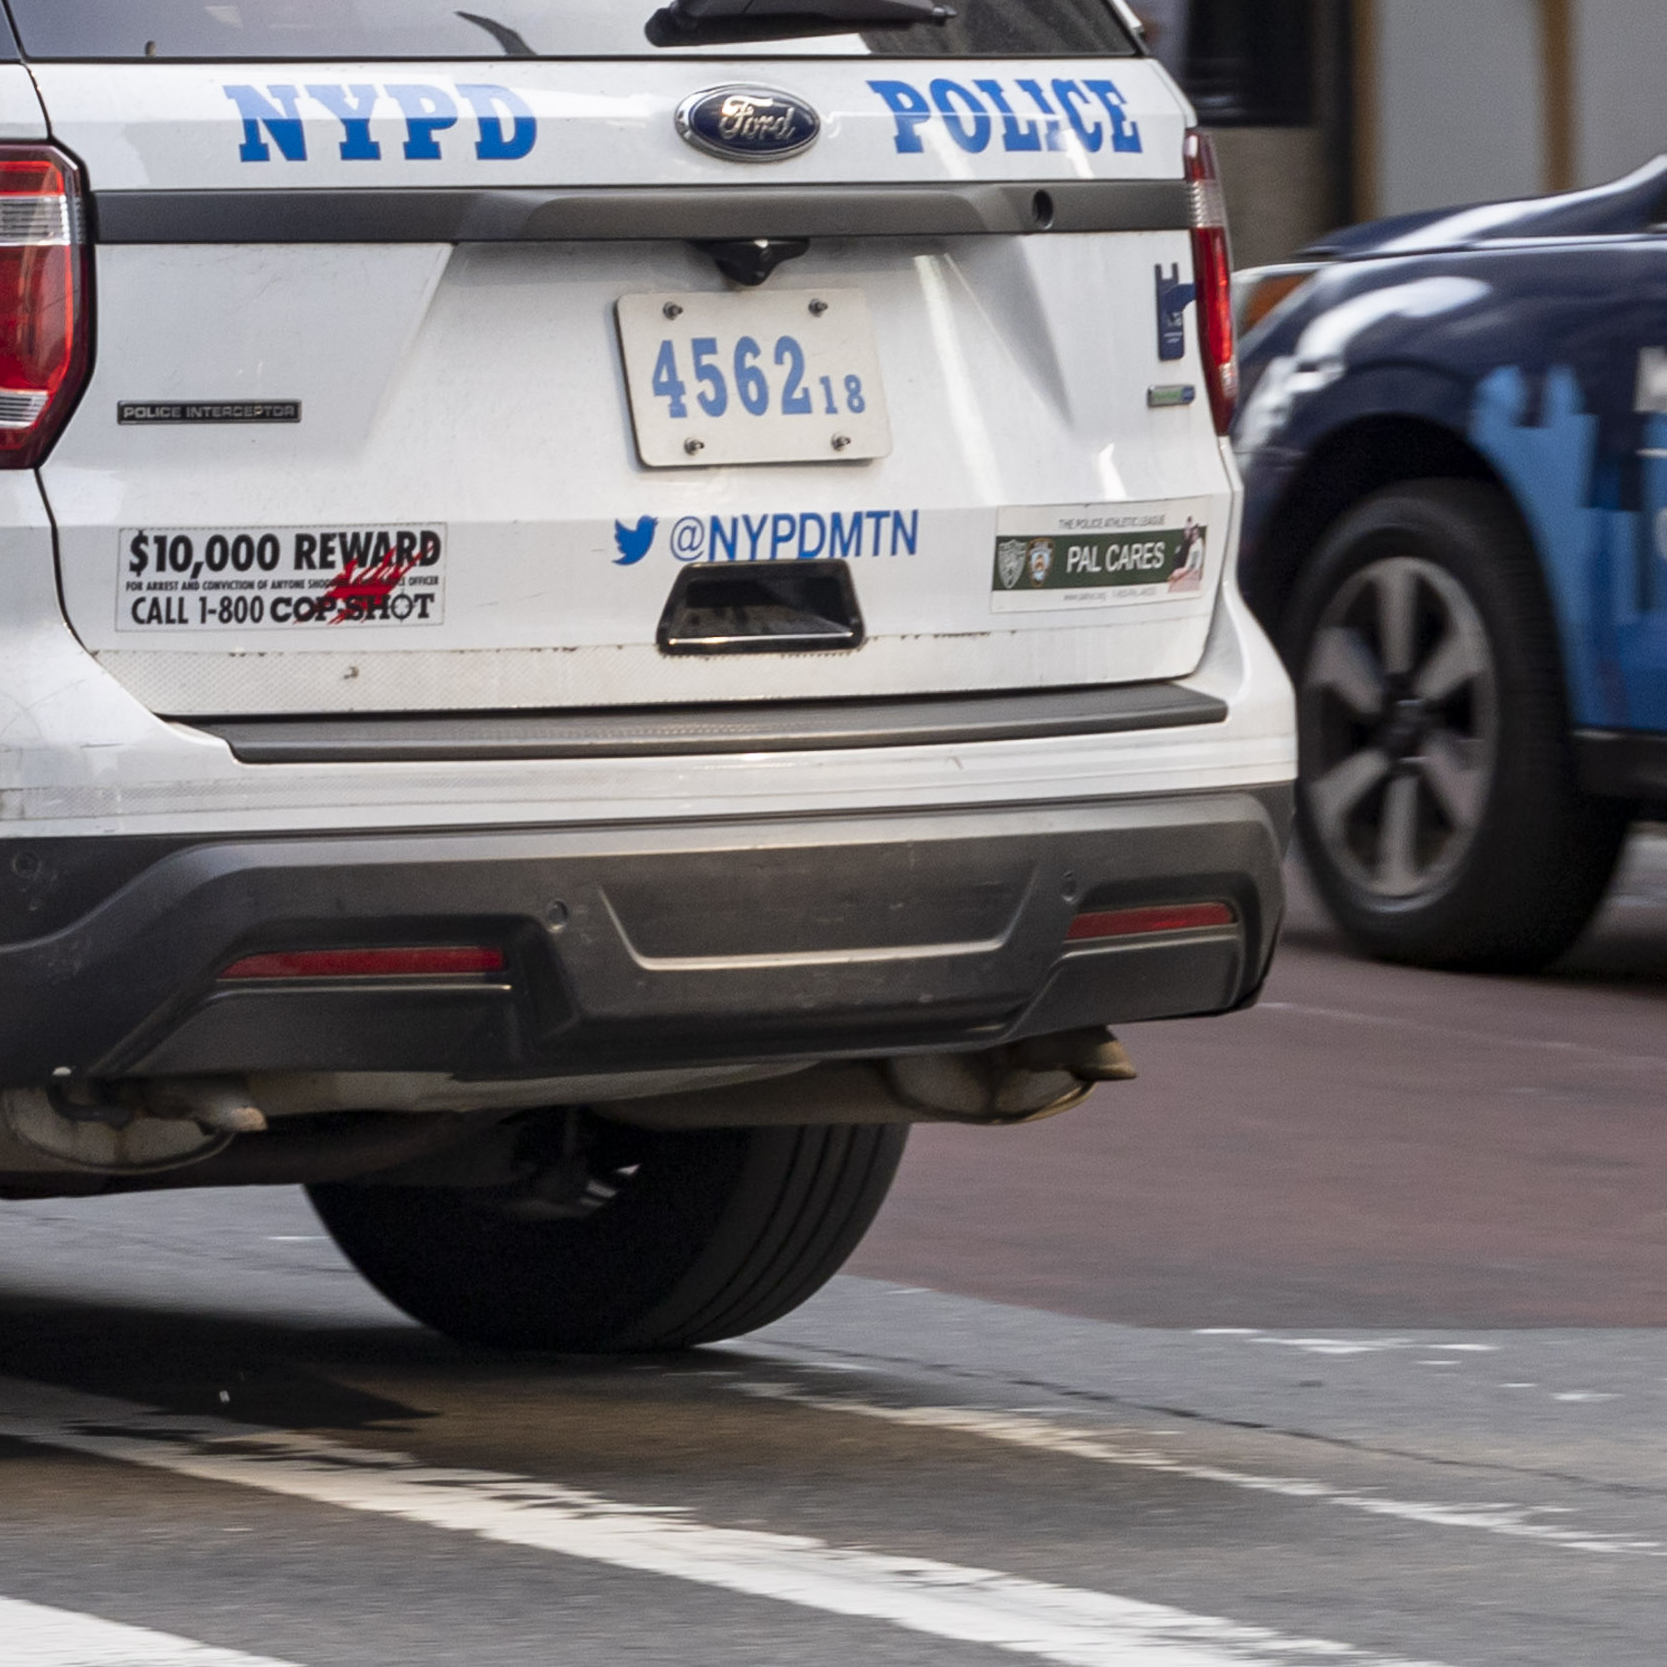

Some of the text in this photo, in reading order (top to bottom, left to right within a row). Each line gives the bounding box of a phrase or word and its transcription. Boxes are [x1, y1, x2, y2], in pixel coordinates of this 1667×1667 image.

[222, 83, 538, 163] NYPD
[718, 95, 797, 140] Ford
[865, 78, 1144, 155] POLICE
[123, 404, 295, 419] POLICE INTERCEPTOR
[129, 529, 442, 580] $10,000 REWARD
[669, 509, 920, 563] @NYPDMTN
[1066, 540, 1166, 574] PAL CARES
[131, 596, 189, 625] CALL
[198, 596, 264, 624] 1-800
